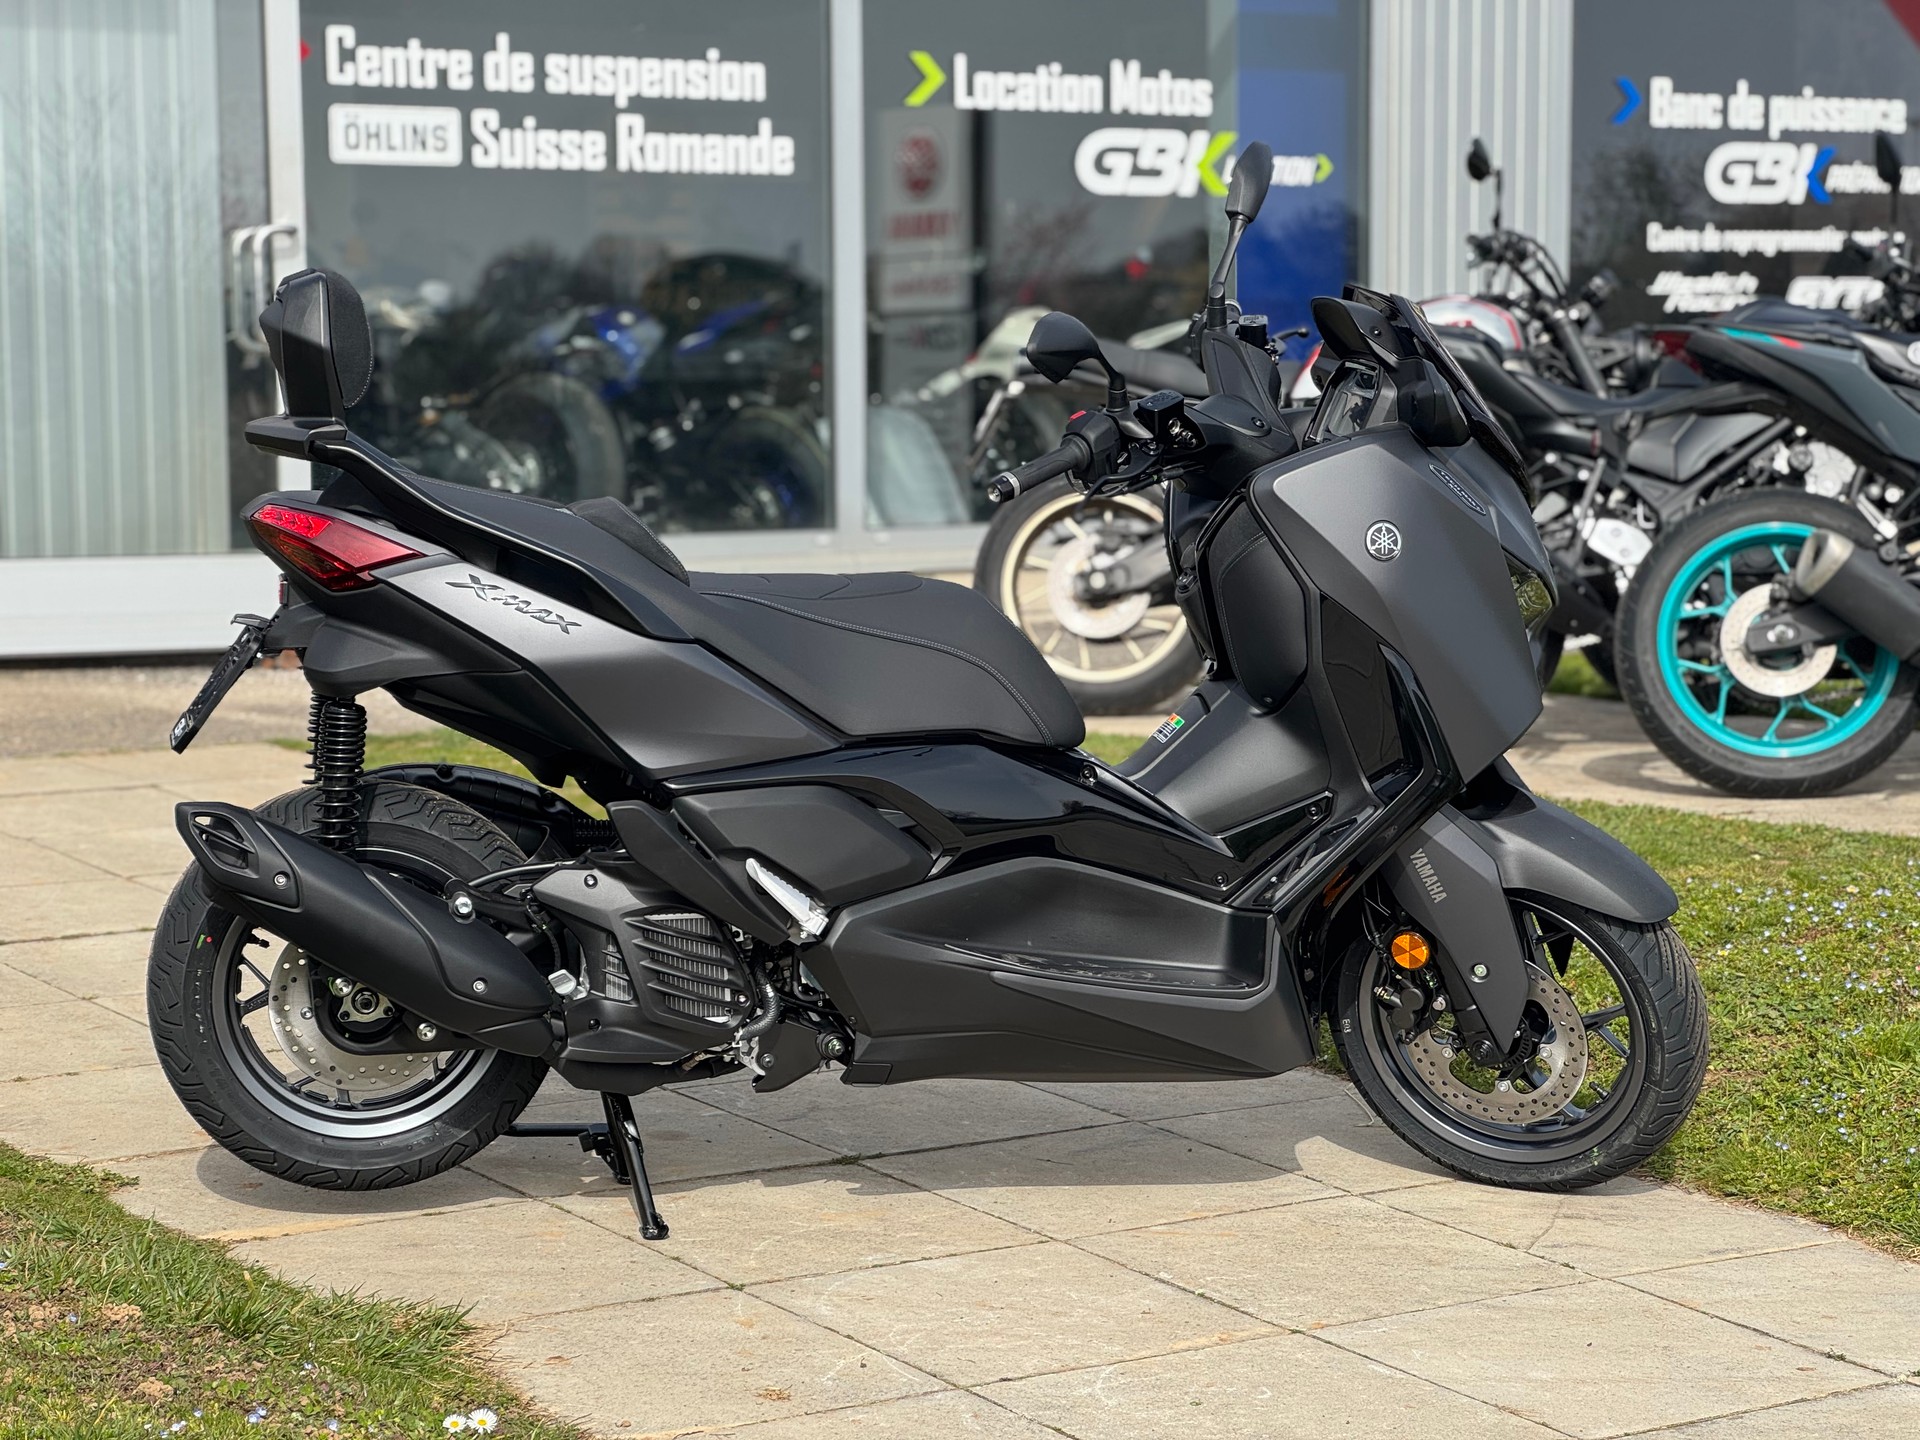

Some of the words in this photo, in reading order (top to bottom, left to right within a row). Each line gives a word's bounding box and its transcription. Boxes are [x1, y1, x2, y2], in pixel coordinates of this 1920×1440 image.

[326, 24, 472, 90] Centre
[483, 32, 534, 92] de
[544, 48, 766, 108] suspension
[953, 53, 1102, 112] Location
[1110, 58, 1213, 117] Motos
[343, 112, 449, 153] ÖHLINS
[1650, 76, 1723, 129] Banc
[1727, 78, 1765, 130] de
[1768, 85, 1907, 141] puissance
[470, 107, 607, 170] Suisse
[616, 113, 795, 175] Romande
[1410, 847, 1448, 904] YAMAHA
